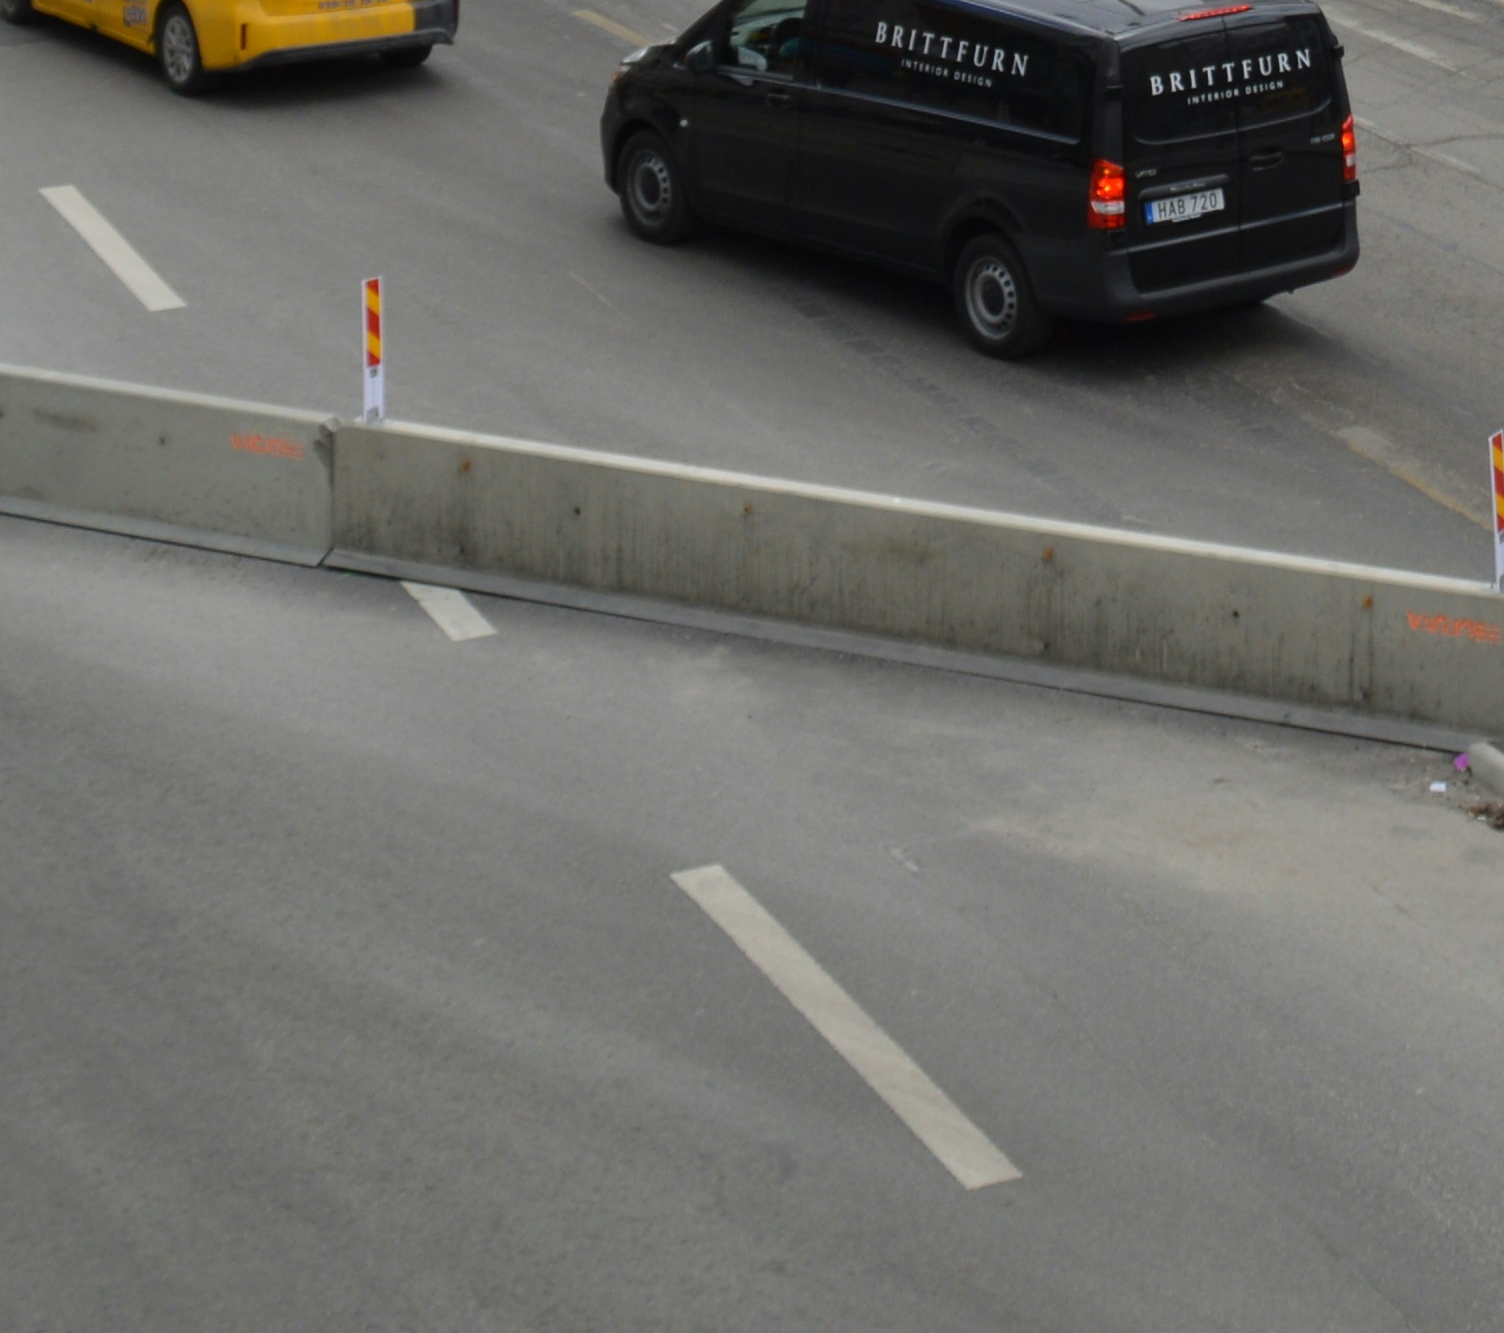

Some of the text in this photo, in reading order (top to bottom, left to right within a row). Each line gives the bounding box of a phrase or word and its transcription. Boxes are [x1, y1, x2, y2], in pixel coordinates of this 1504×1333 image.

[875, 21, 1030, 77] BRITTFURN
[901, 58, 993, 89] INTERIOR DESIGN
[1149, 48, 1312, 96] BRITTFURN
[1187, 79, 1284, 106] INTERIOR DESIGN
[1157, 191, 1218, 220] HAB 720
